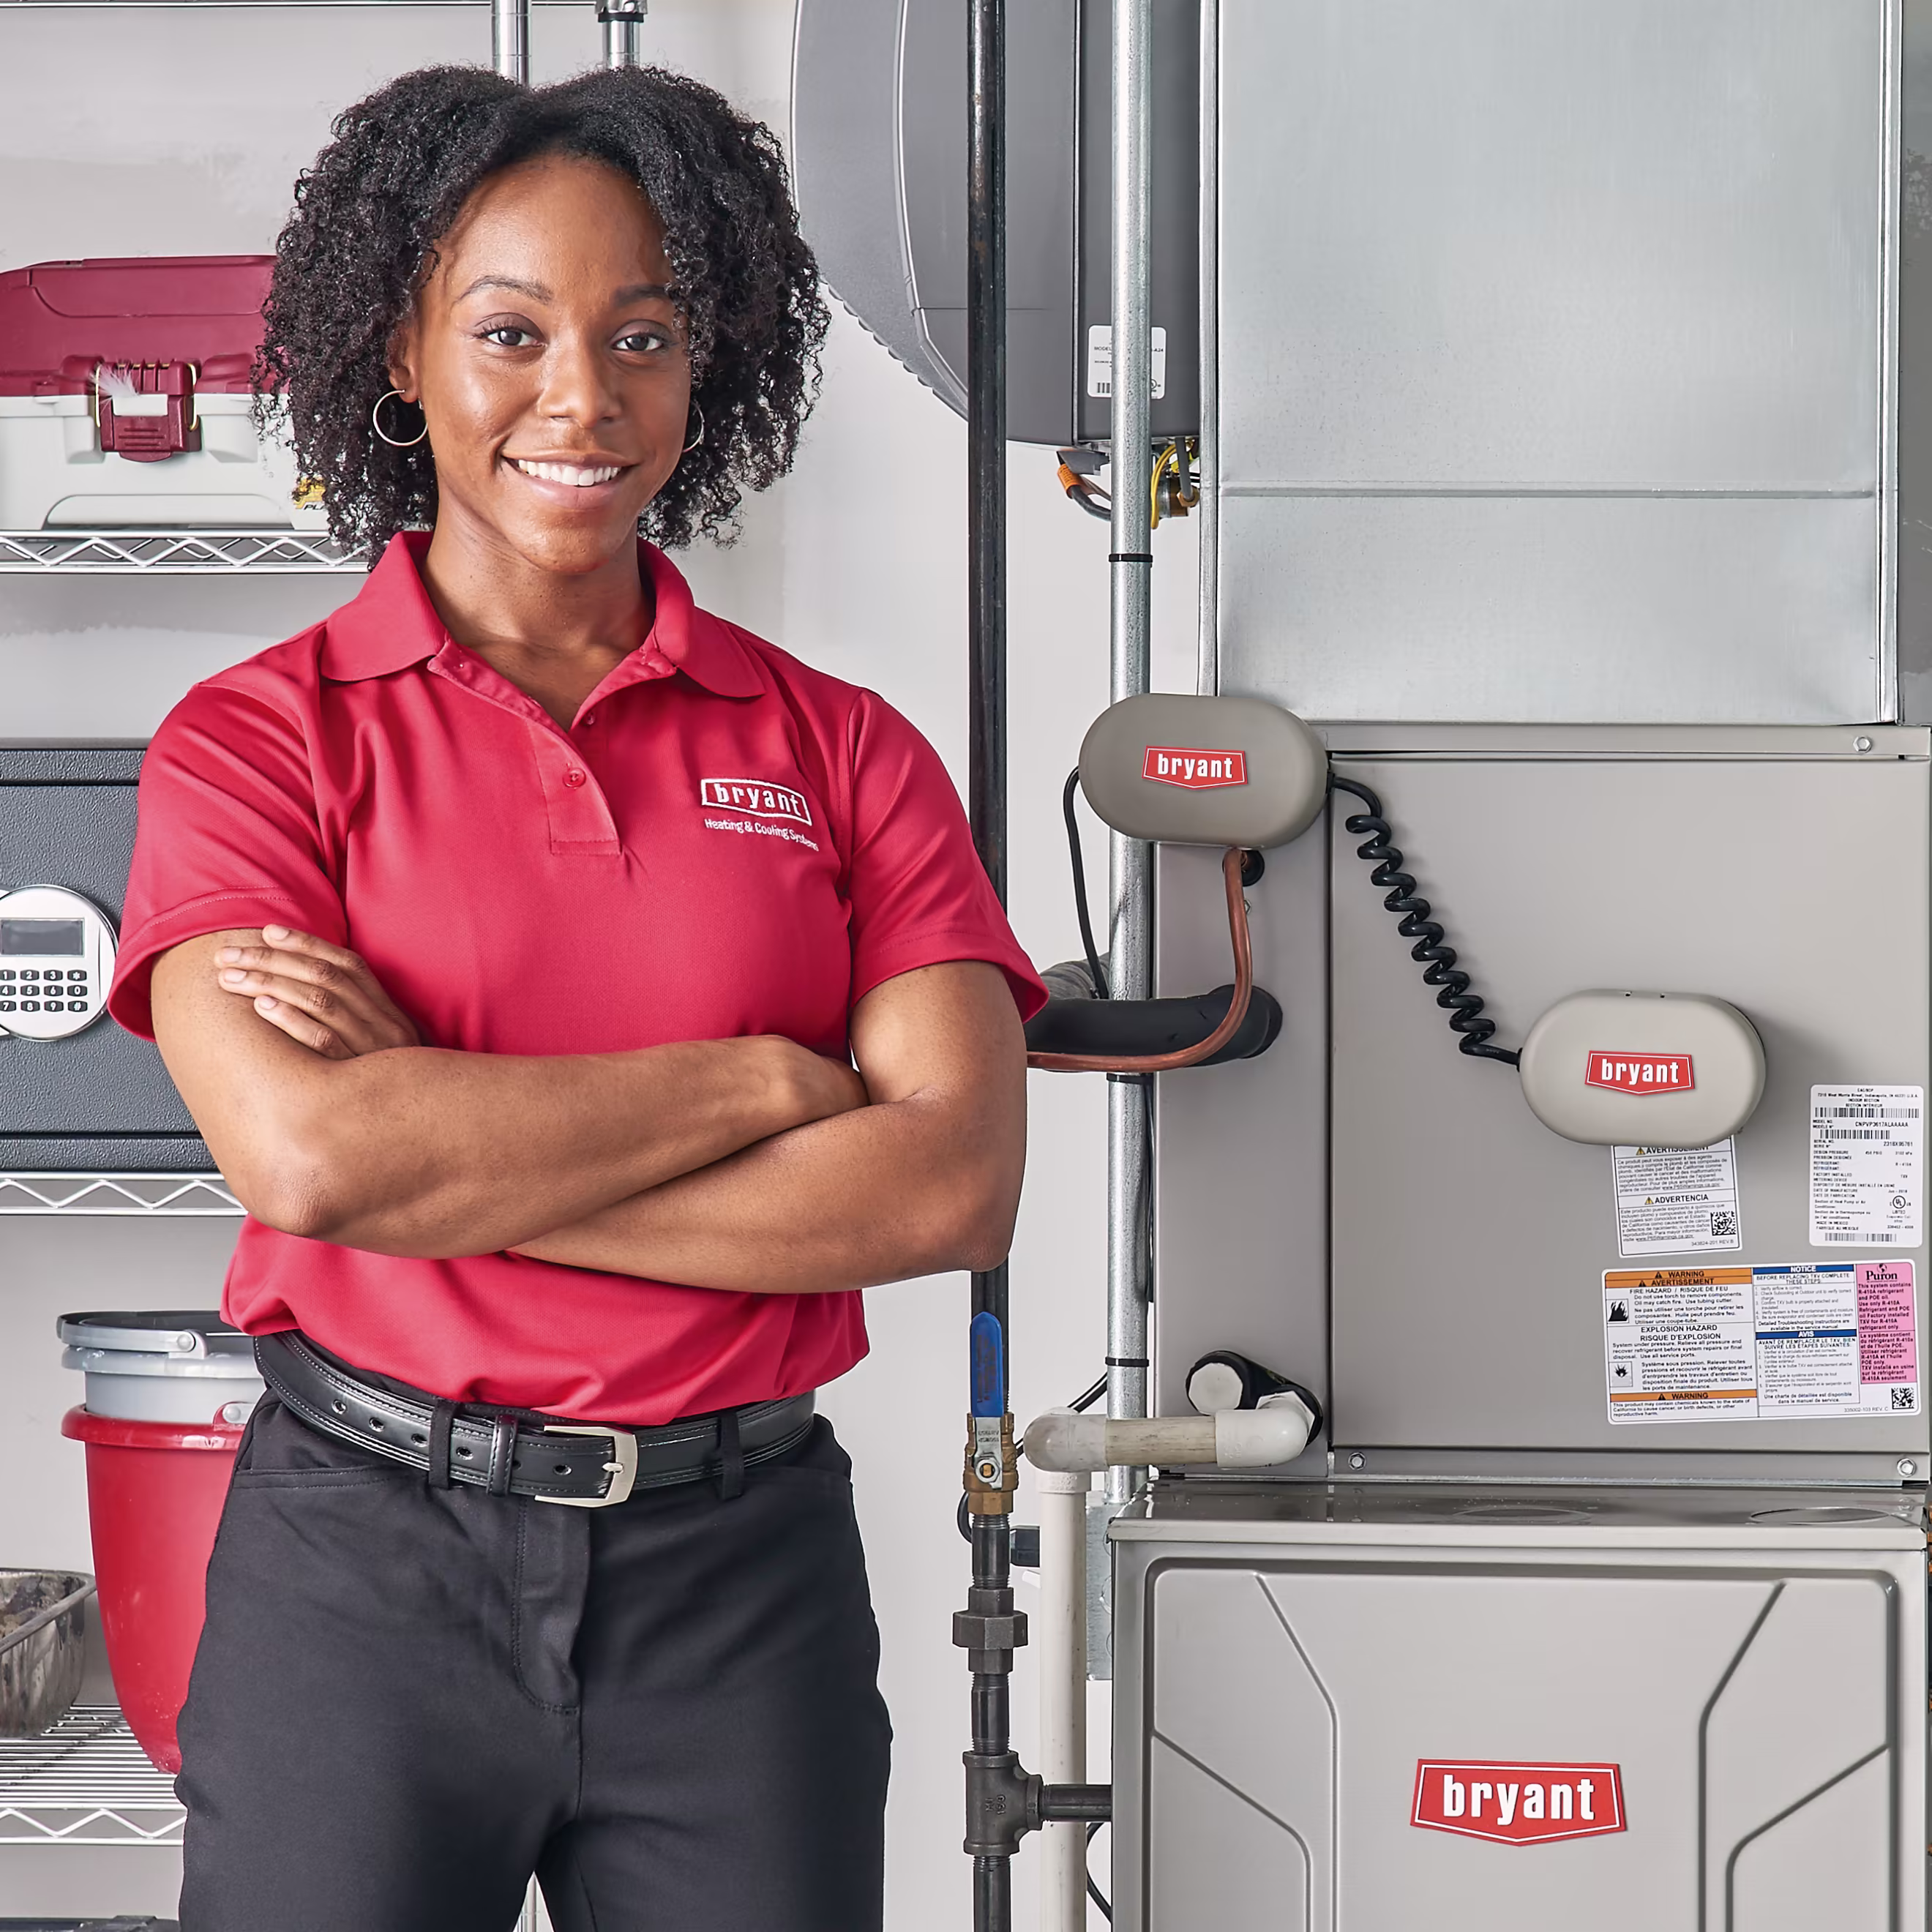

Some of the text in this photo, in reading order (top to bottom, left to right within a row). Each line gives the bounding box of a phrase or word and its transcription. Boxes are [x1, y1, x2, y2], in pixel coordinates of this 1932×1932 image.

[1157, 753, 1232, 780] bryant
[714, 783, 801, 816] bryant
[705, 819, 744, 834] Heating
[744, 821, 754, 832] &
[755, 823, 789, 840] Cooling
[3, 971, 7, 980] 1
[26, 971, 33, 980] 2
[50, 971, 56, 980] 3
[2, 986, 8, 995] 4
[26, 986, 33, 995] 5
[50, 986, 56, 995] 6
[74, 986, 81, 995] 0
[3, 1002, 9, 1011] 7
[27, 1002, 33, 1011] 8
[50, 1002, 56, 1011] 9
[1602, 1058, 1679, 1085] bryant
[1655, 1194, 1709, 1204] ADVERTENCIA
[1866, 1270, 1897, 1280] Puron
[1651, 1278, 1713, 1286] AVERTISSEMENT
[1444, 1774, 1595, 1825] bryant
